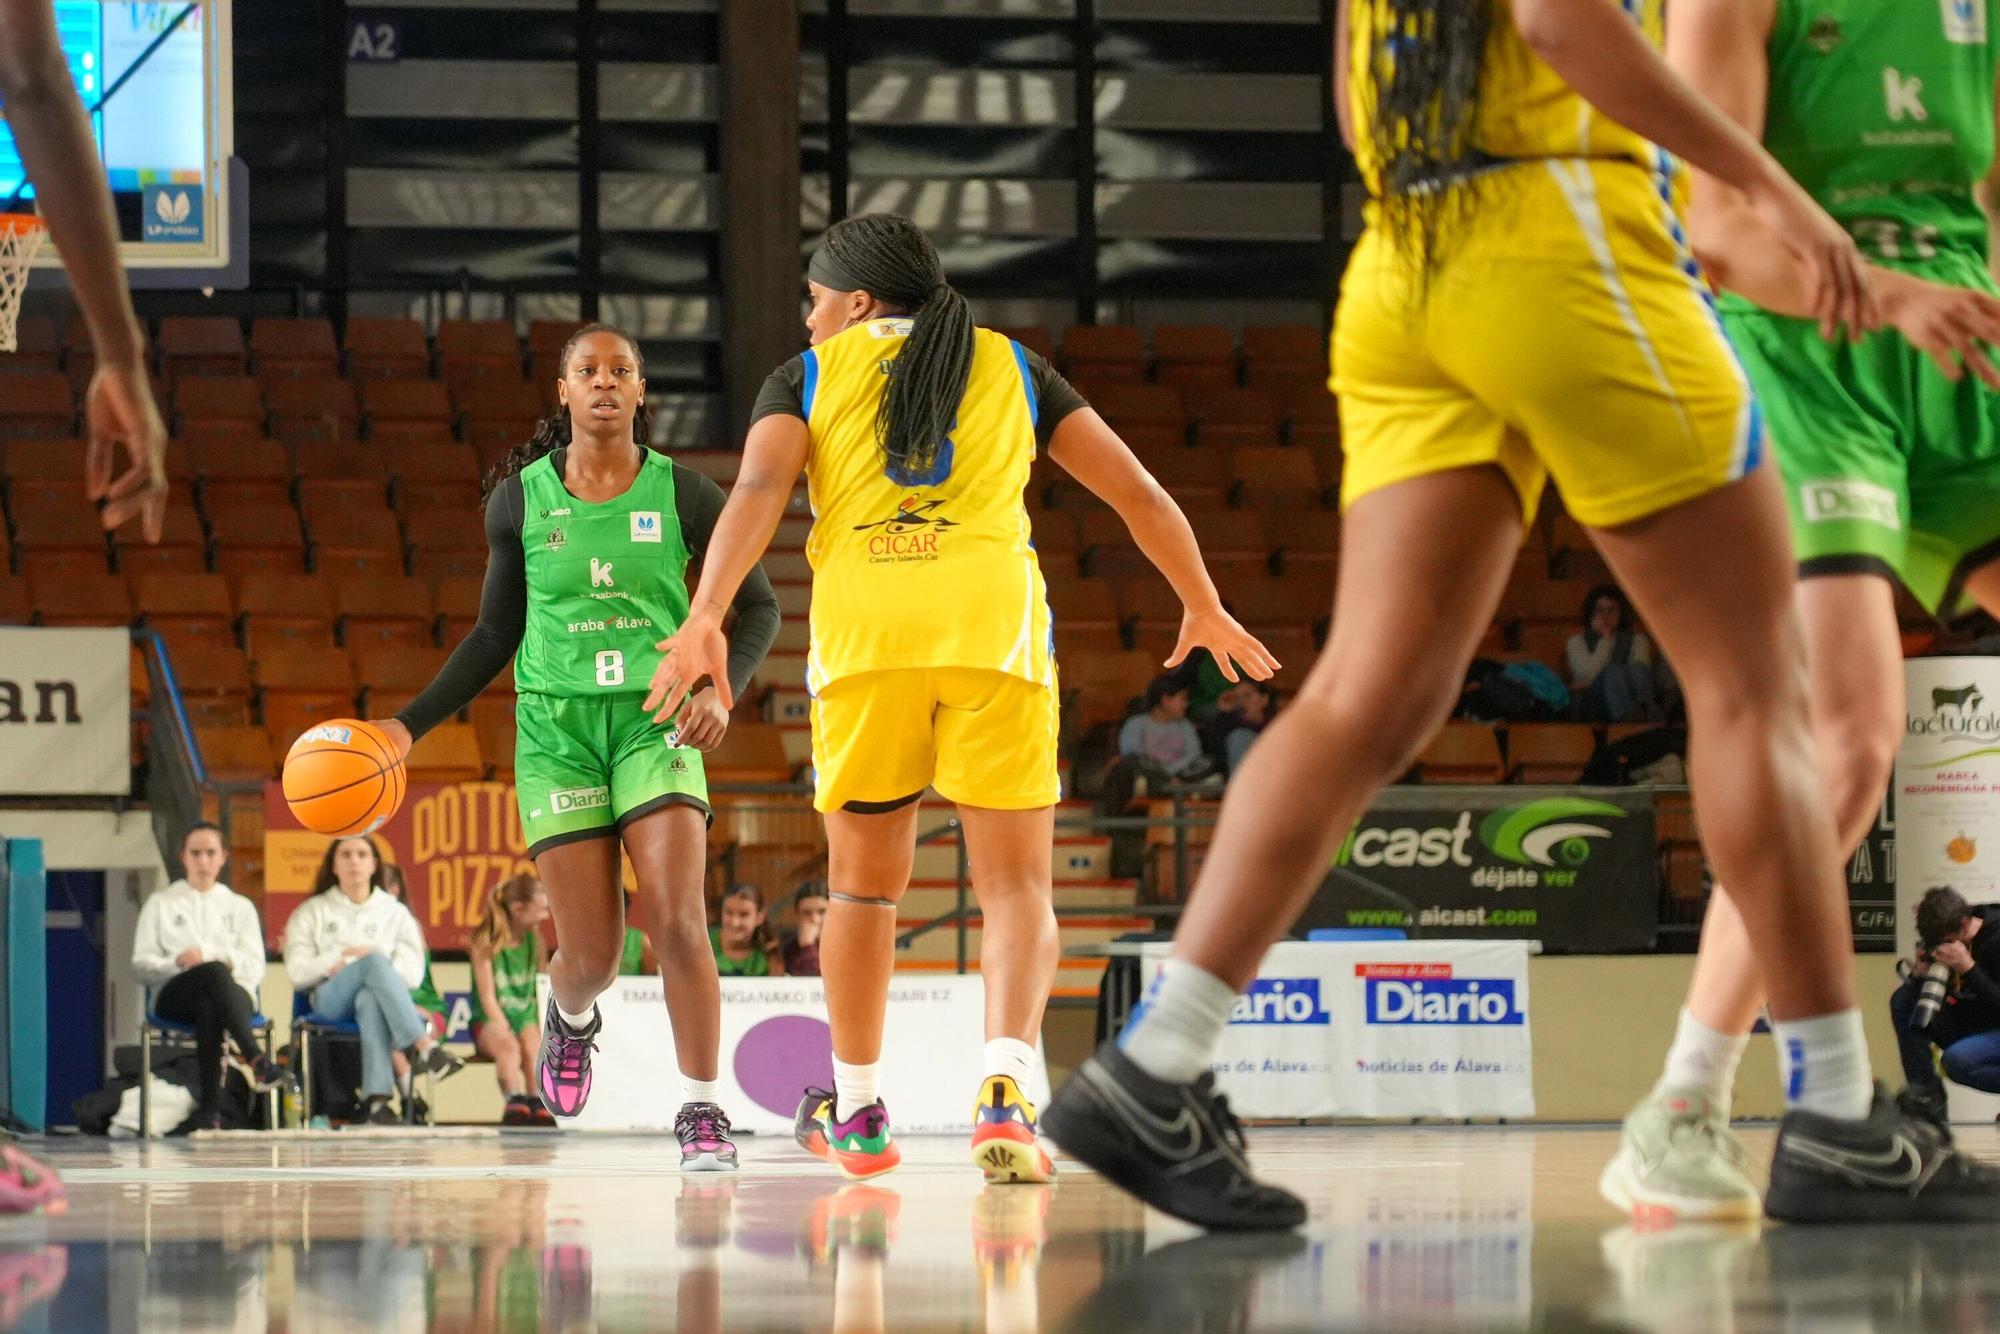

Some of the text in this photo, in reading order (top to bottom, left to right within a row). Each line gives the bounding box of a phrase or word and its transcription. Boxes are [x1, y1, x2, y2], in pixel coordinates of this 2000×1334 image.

[349, 23, 396, 57] A2
[869, 533, 938, 555] CICAR
[567, 616, 652, 633] araba álava
[595, 649, 625, 687] 8
[0, 680, 82, 724] an
[557, 789, 610, 811] Diario
[1331, 811, 1473, 867] icast
[429, 854, 538, 928] PIZZ
[1471, 866, 1578, 891] déjate ver
[1231, 981, 1314, 1022] ario
[1376, 981, 1508, 1022] Diario
[1236, 1058, 1256, 1073] de
[1429, 1058, 1449, 1073] de
